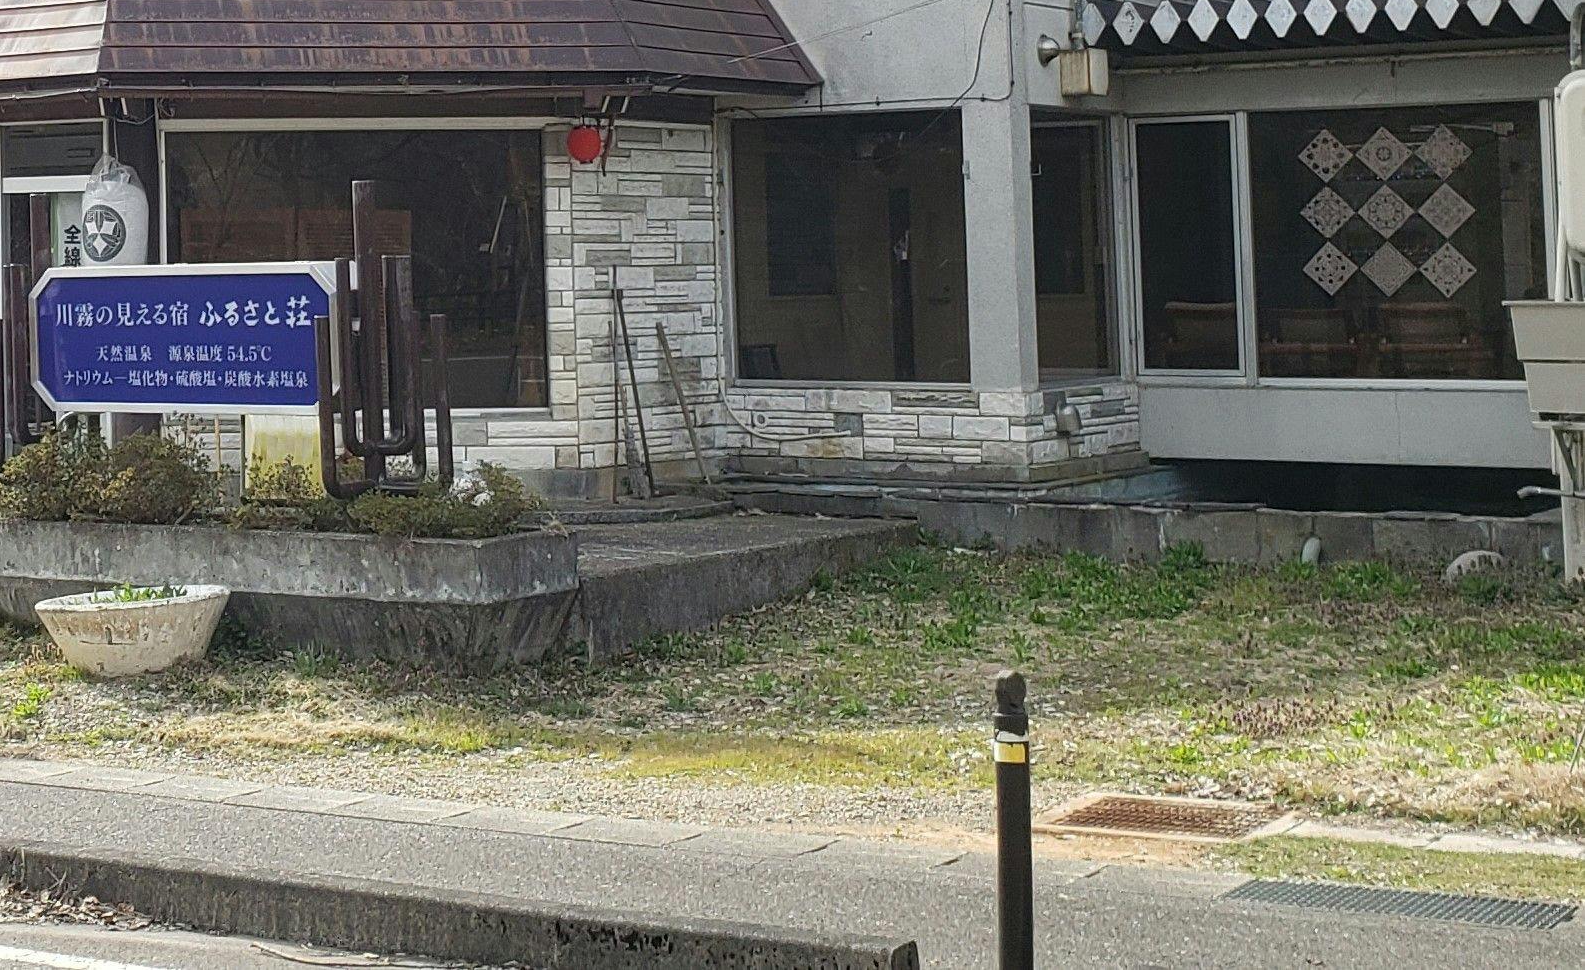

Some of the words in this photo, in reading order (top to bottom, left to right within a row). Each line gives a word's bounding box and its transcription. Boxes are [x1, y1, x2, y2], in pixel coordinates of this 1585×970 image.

[55, 300, 190, 328] 川霧の見える宿
[198, 294, 312, 329] ふるさと荘
[95, 344, 153, 363] 天然温泉
[168, 344, 224, 363] 源泉温度
